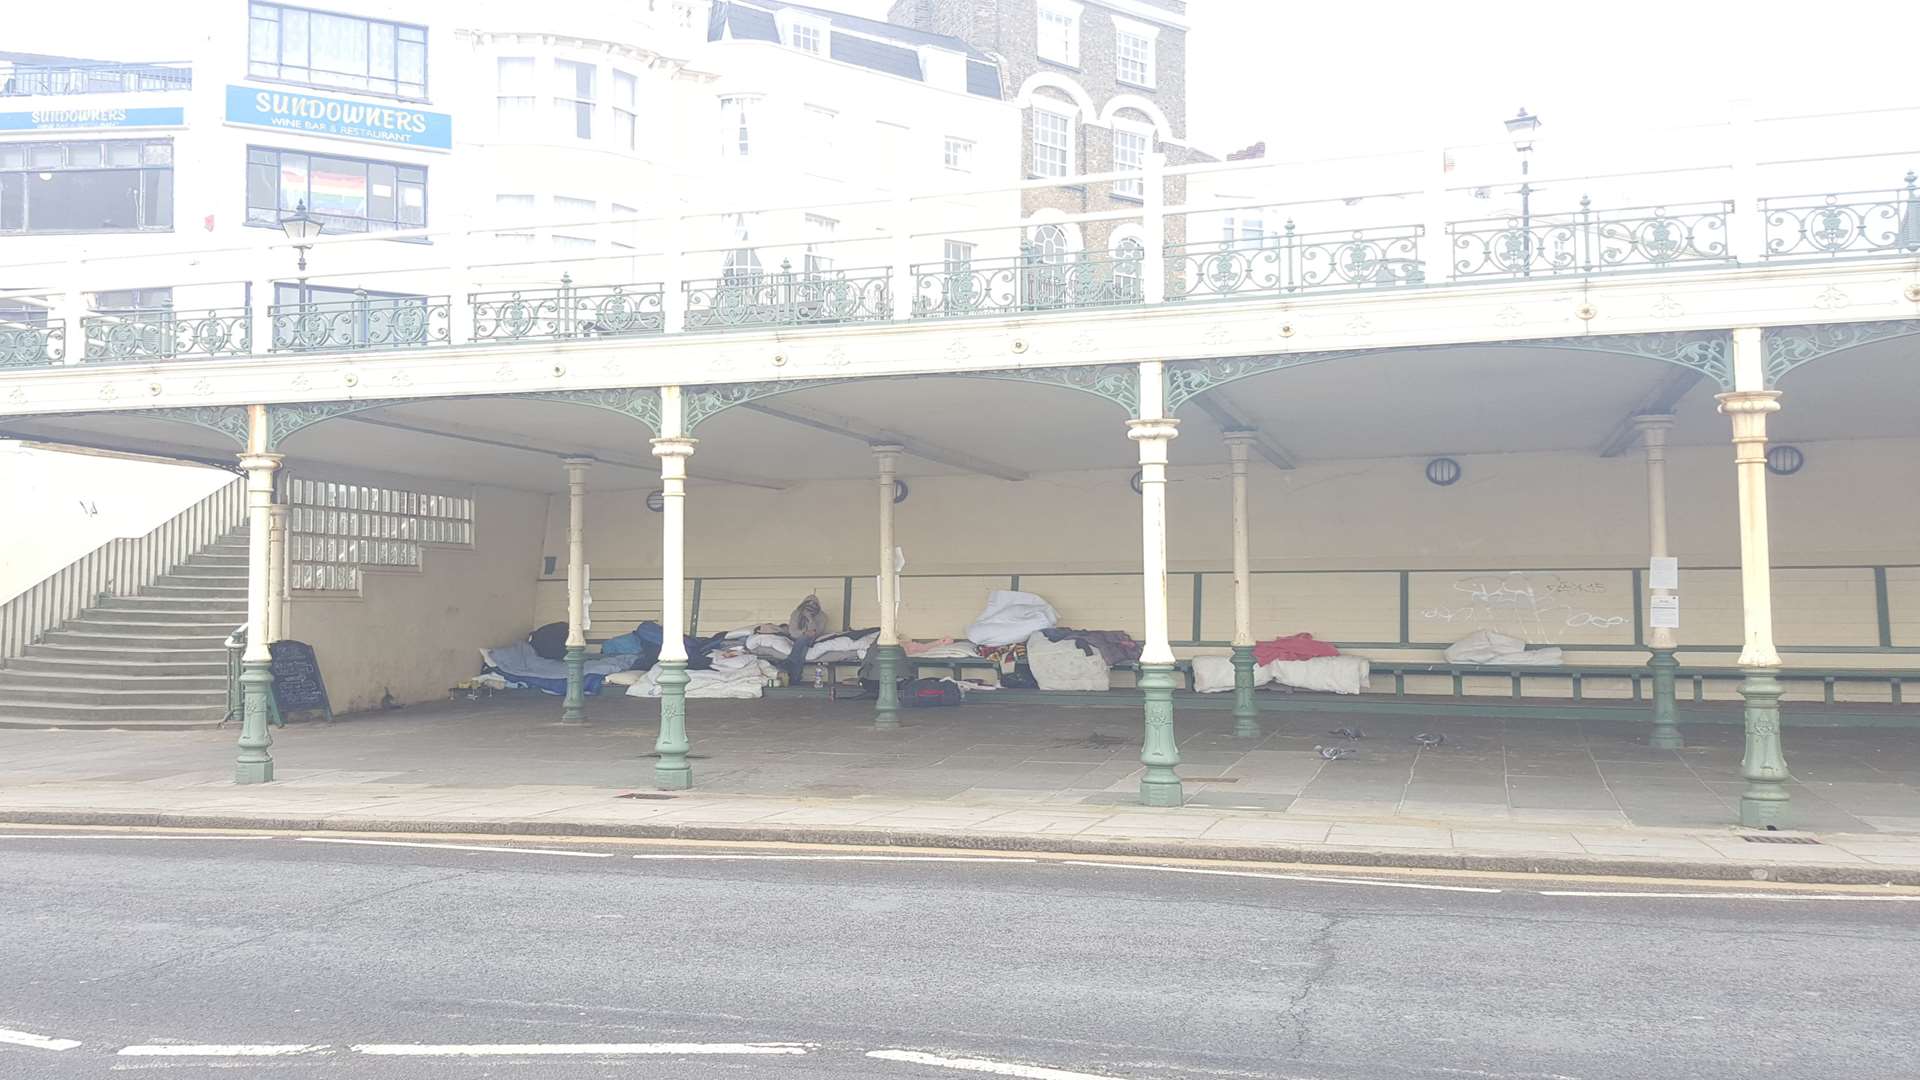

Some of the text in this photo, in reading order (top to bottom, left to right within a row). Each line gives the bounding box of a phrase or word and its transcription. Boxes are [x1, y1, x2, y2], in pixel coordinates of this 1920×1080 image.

[32, 108, 127, 123] SUNDOWNERS
[255, 92, 427, 133] SUNDOWNERS
[271, 117, 302, 128] WINE
[305, 121, 326, 130] BAR
[341, 126, 412, 142] RESTAURANT
